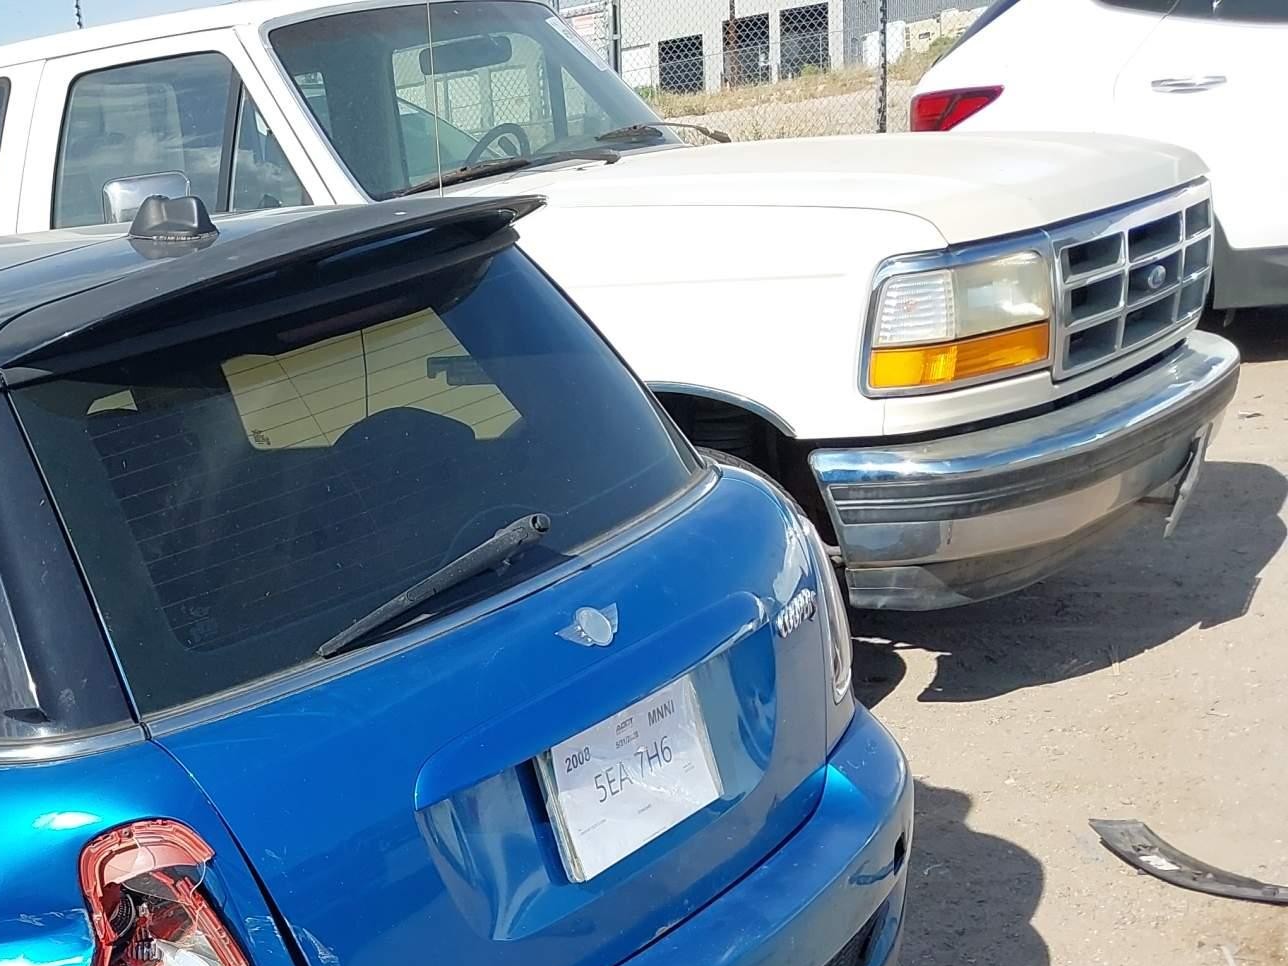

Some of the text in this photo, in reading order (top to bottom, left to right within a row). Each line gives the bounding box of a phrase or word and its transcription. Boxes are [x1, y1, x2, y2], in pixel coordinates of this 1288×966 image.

[648, 699, 675, 727] MNNI
[565, 747, 592, 774] 2008
[594, 735, 673, 803] 5EA 7H6
